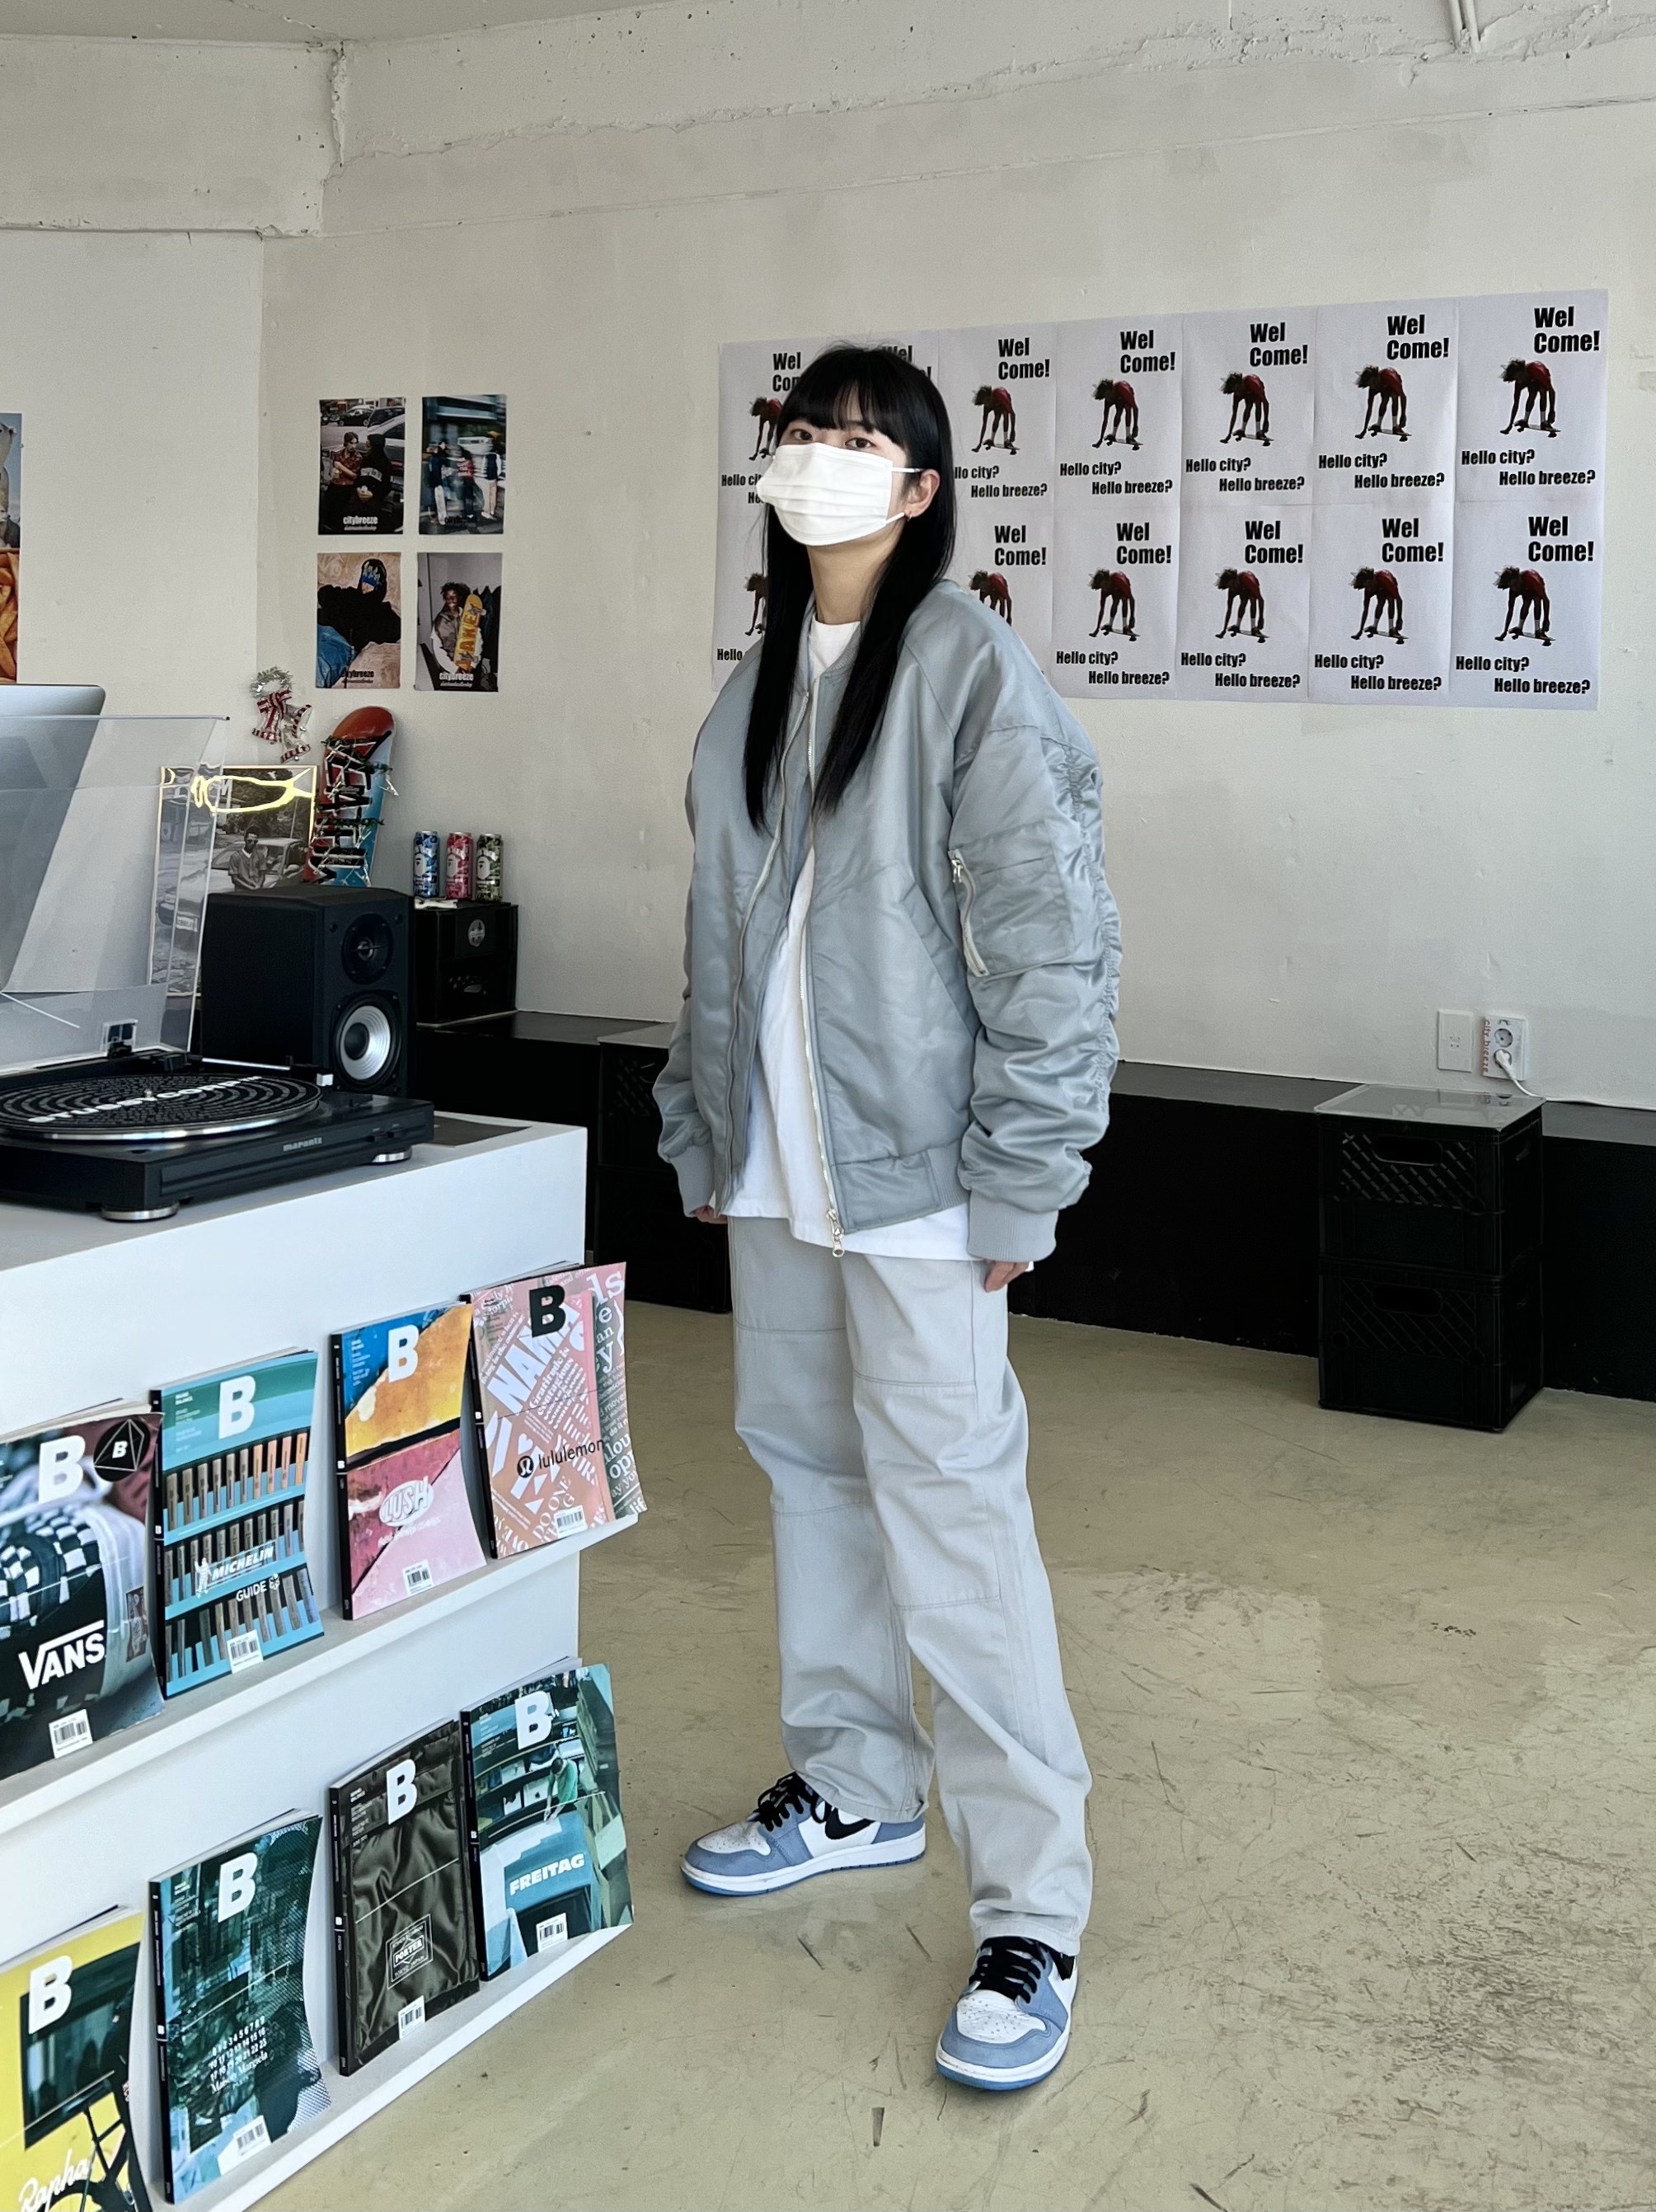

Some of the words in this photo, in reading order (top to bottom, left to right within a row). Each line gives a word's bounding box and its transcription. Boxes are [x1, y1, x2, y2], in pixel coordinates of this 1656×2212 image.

[1387, 314, 1425, 336] Wel
[1533, 306, 1574, 328] Wel
[1120, 330, 1154, 350] Wel
[1250, 322, 1285, 343] Wel
[1533, 331, 1600, 354] Come!
[998, 337, 1030, 357] Wel
[1250, 345, 1308, 367] Come!
[1386, 338, 1449, 360] Come!
[772, 352, 800, 370] Wel
[998, 359, 1050, 380] Come!
[1120, 352, 1175, 373] Come!
[772, 373, 800, 392] Com
[1185, 458, 1216, 472] Hello
[1219, 458, 1251, 472] city?
[1319, 455, 1352, 469] Hello
[1354, 453, 1387, 468] city?
[1461, 450, 1496, 465] Hello
[1499, 449, 1535, 465] city?
[721, 473, 746, 486] Hello
[955, 467, 969, 480] llo
[971, 465, 999, 480] city?
[1060, 463, 1089, 477] Hello
[1091, 462, 1122, 477] city?
[1499, 471, 1536, 486] Hello
[1539, 470, 1596, 486] breeze?
[971, 485, 1000, 498] Hello
[1002, 483, 1048, 498] breeze?
[1091, 481, 1122, 495] Hello
[1124, 480, 1173, 494] breeze?
[1219, 477, 1251, 492] Hello
[1255, 477, 1305, 491] breeze?
[1354, 474, 1388, 489] Hello
[1391, 472, 1445, 488] breeze?
[994, 525, 1026, 543] Wel
[1116, 522, 1150, 542] Wel
[1245, 520, 1281, 540] Wel
[1382, 518, 1419, 538] Wel
[1528, 515, 1569, 537] Wel
[994, 547, 1047, 566] Come!
[1116, 545, 1171, 565] Come!
[1245, 544, 1303, 564] Come!
[1382, 542, 1444, 563] Come!
[1527, 541, 1594, 562] Come!
[716, 648, 743, 661] Hello
[1056, 650, 1086, 665] Hello
[1088, 651, 1119, 665] city?
[1180, 652, 1213, 666] Hello
[1215, 652, 1246, 667] city?
[1314, 654, 1348, 669] Hello
[1351, 655, 1384, 670] city?
[1456, 656, 1491, 671] Hello
[1494, 656, 1529, 673] city?
[1088, 671, 1119, 684] Hello
[1121, 671, 1170, 685] breeze?
[1215, 673, 1246, 687] Hello
[1250, 674, 1301, 688] breeze?
[1350, 675, 1385, 690] Hello
[1388, 676, 1442, 692] breeze?
[1494, 678, 1530, 693] Hello
[1533, 679, 1591, 695] breeze?
[283, 1137, 322, 1152] marantz
[529, 1284, 566, 1338] B
[388, 1325, 420, 1383] B
[218, 1375, 256, 1439] B
[538, 1439, 604, 1470] lululemon
[39, 1435, 86, 1505] B
[383, 1476, 429, 1521] LUSH
[212, 1547, 274, 1580] MICHELIN
[236, 1580, 267, 1602] GUIDE
[18, 1619, 106, 1690] VANS
[514, 1691, 552, 1749] B
[386, 1759, 418, 1825] B
[509, 1853, 585, 1896] FREITAG
[218, 1853, 257, 1923] B
[395, 1938, 423, 1963] PORTER
[28, 1955, 73, 2035] B
[19, 2149, 91, 2212] Rapha
